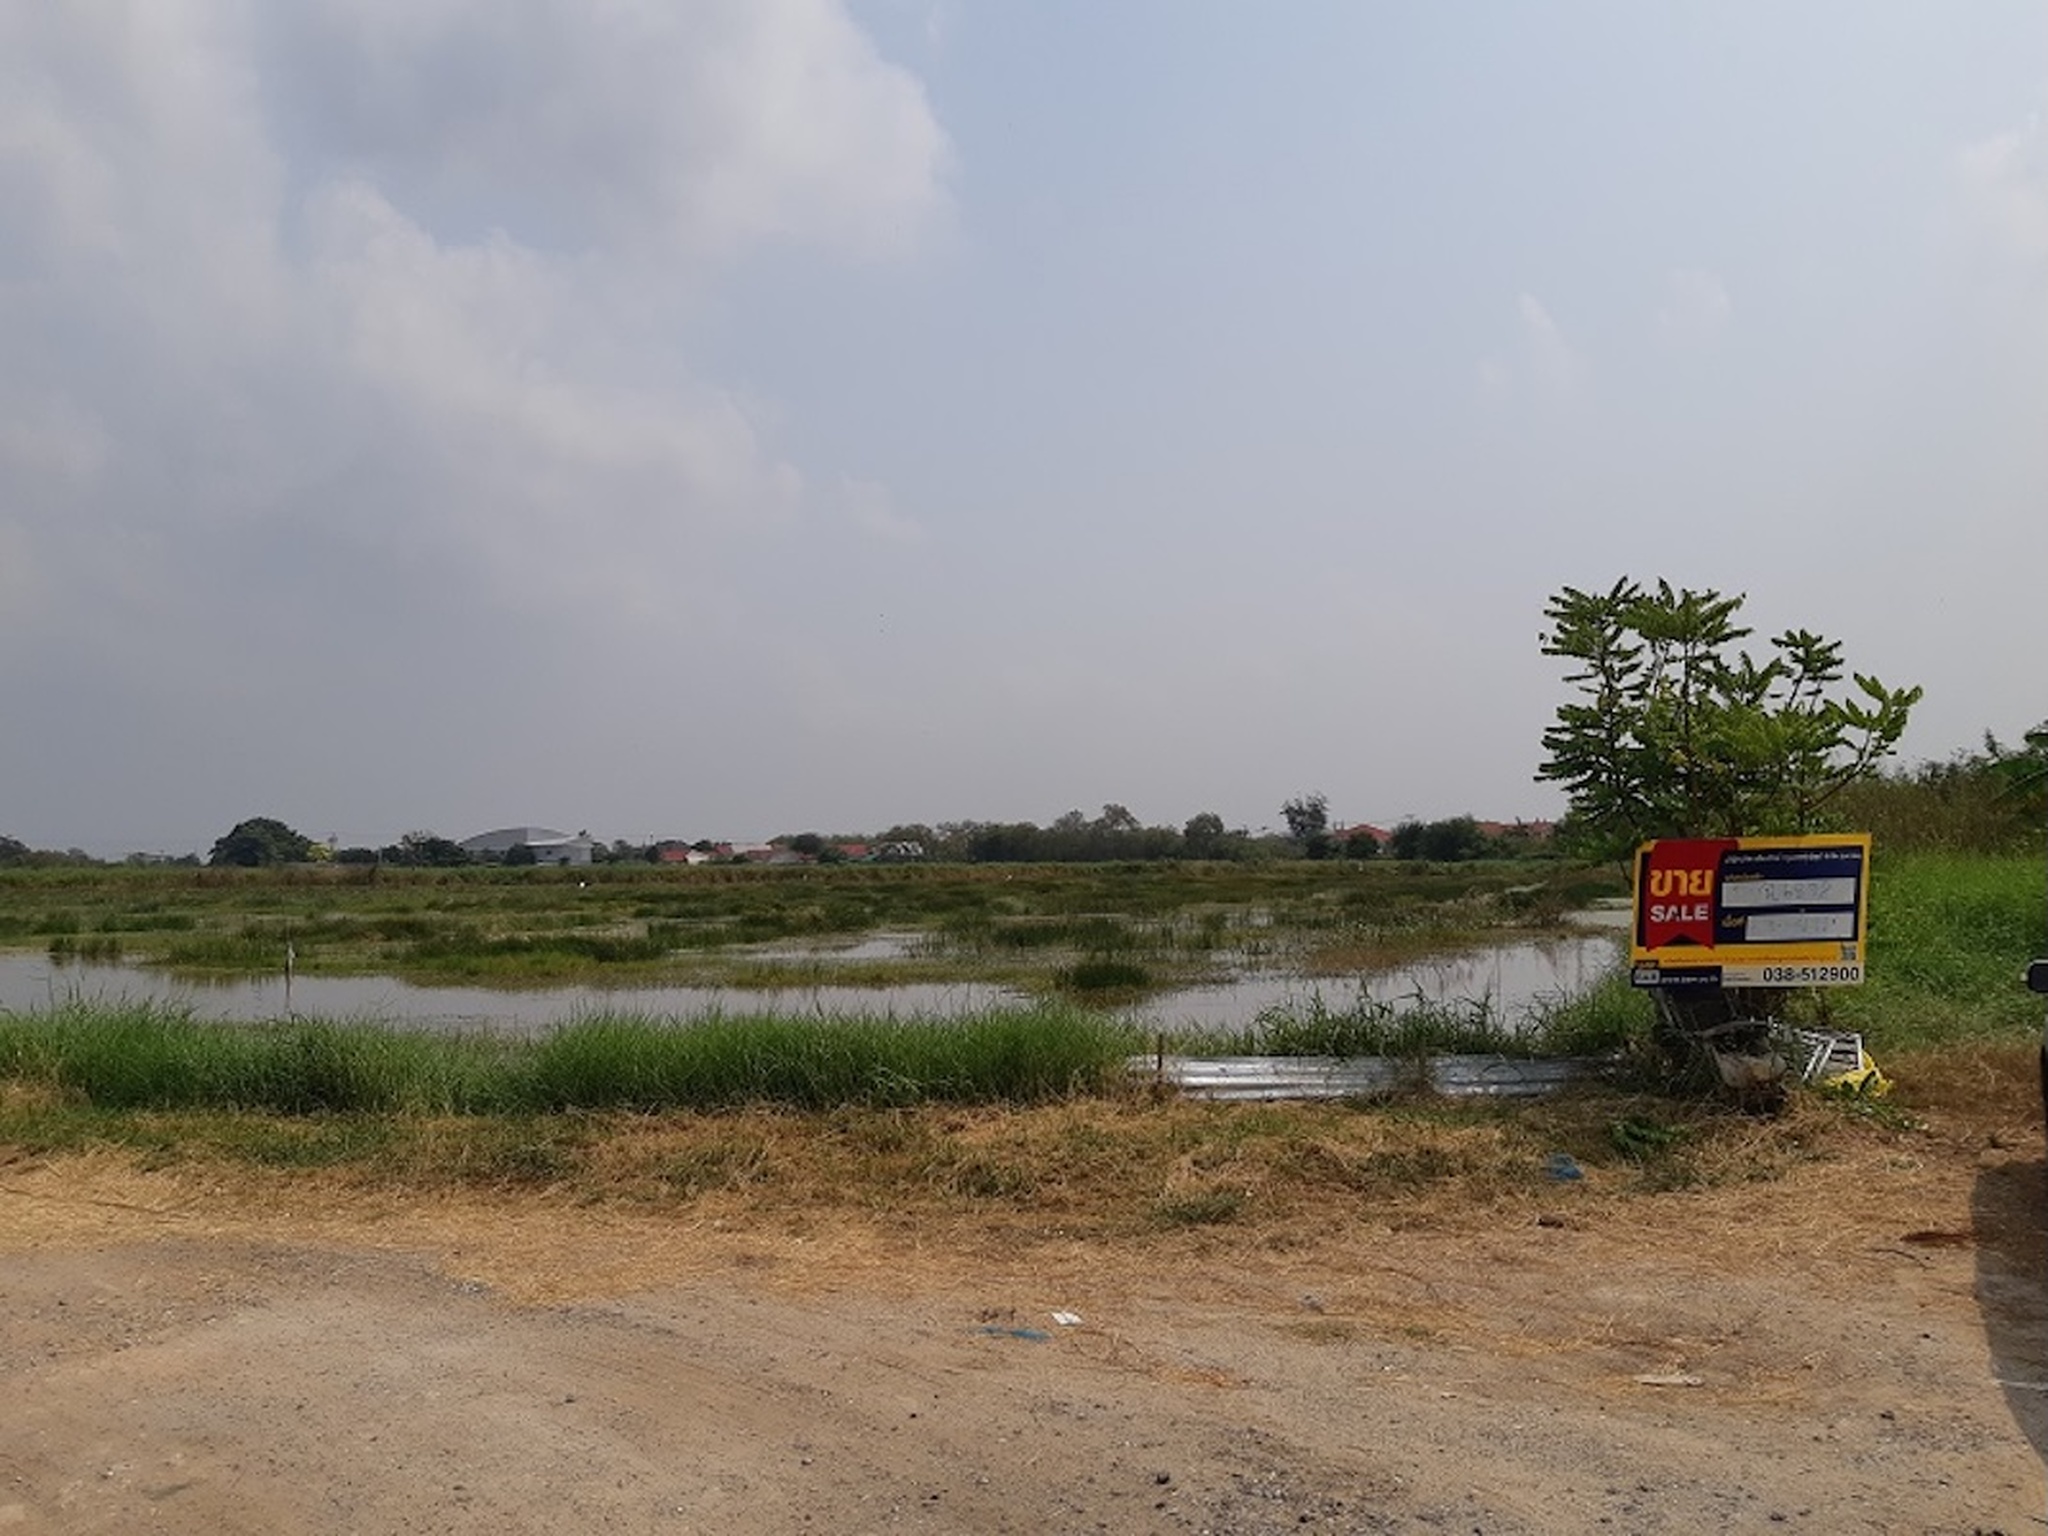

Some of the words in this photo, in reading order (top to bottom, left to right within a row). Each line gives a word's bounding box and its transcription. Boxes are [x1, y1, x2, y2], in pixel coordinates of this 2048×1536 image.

[1650, 869, 1714, 897] ขาย
[1650, 903, 1709, 922] SALE
[1763, 966, 1860, 982] 038-512900
